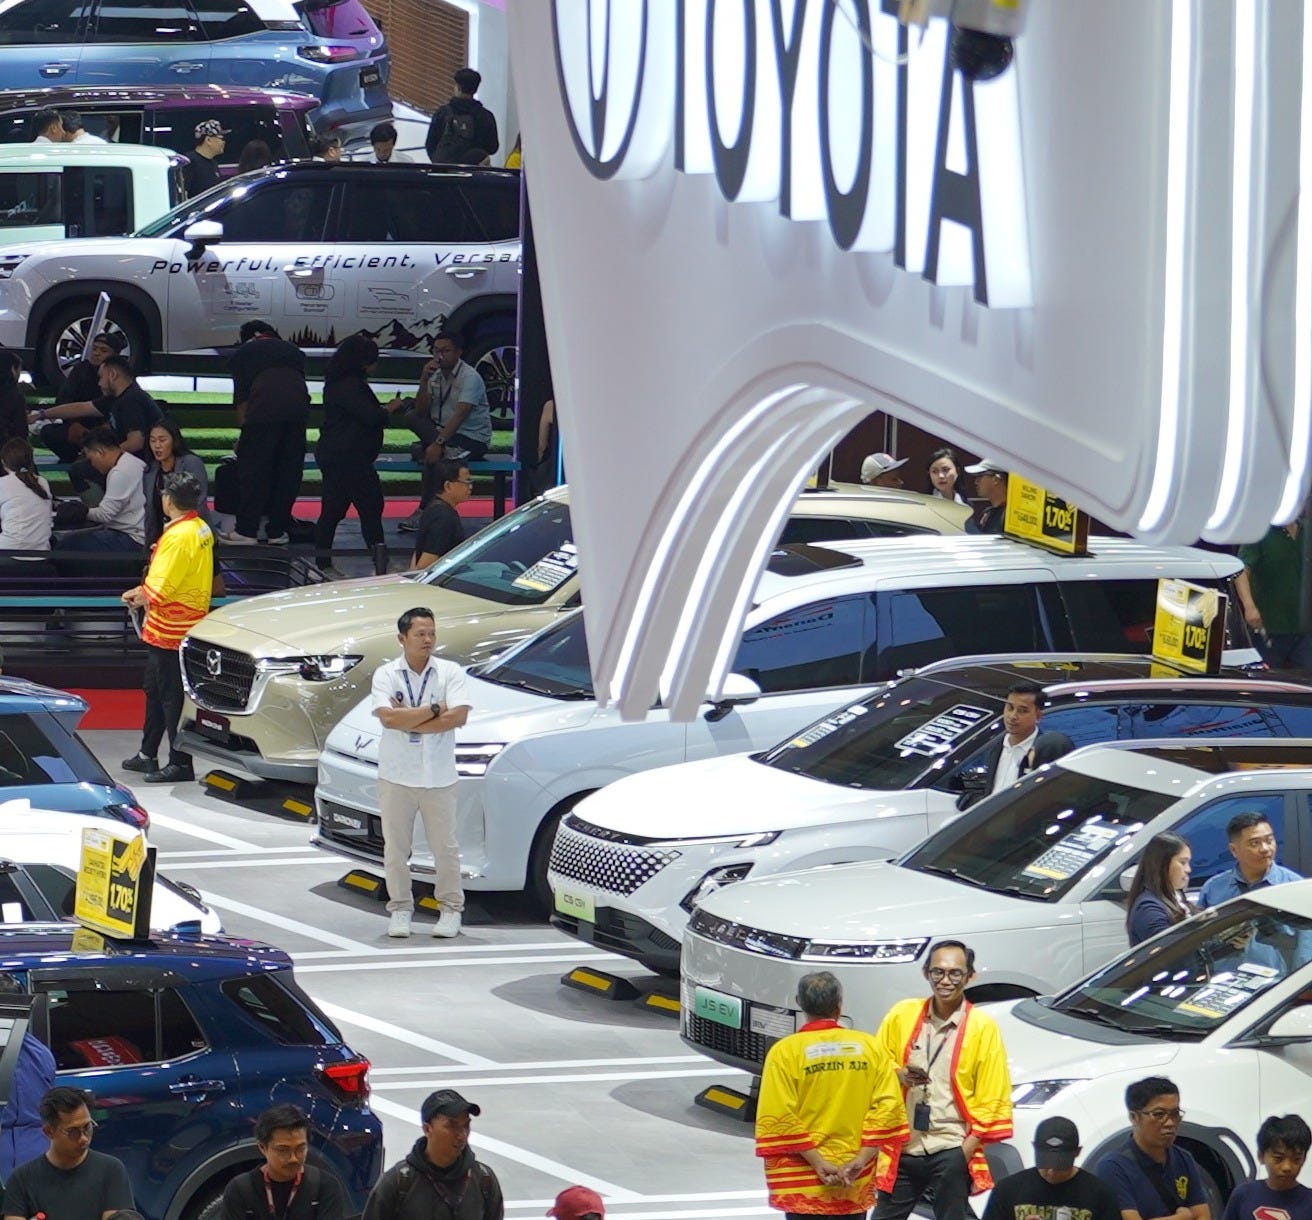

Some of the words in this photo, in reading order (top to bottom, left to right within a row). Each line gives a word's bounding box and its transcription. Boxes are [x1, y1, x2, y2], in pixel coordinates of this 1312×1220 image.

[150, 257, 279, 276] Powerful,
[293, 253, 417, 271] Efficient,
[435, 251, 522, 266] Versa
[718, 1005, 736, 1018] EV
